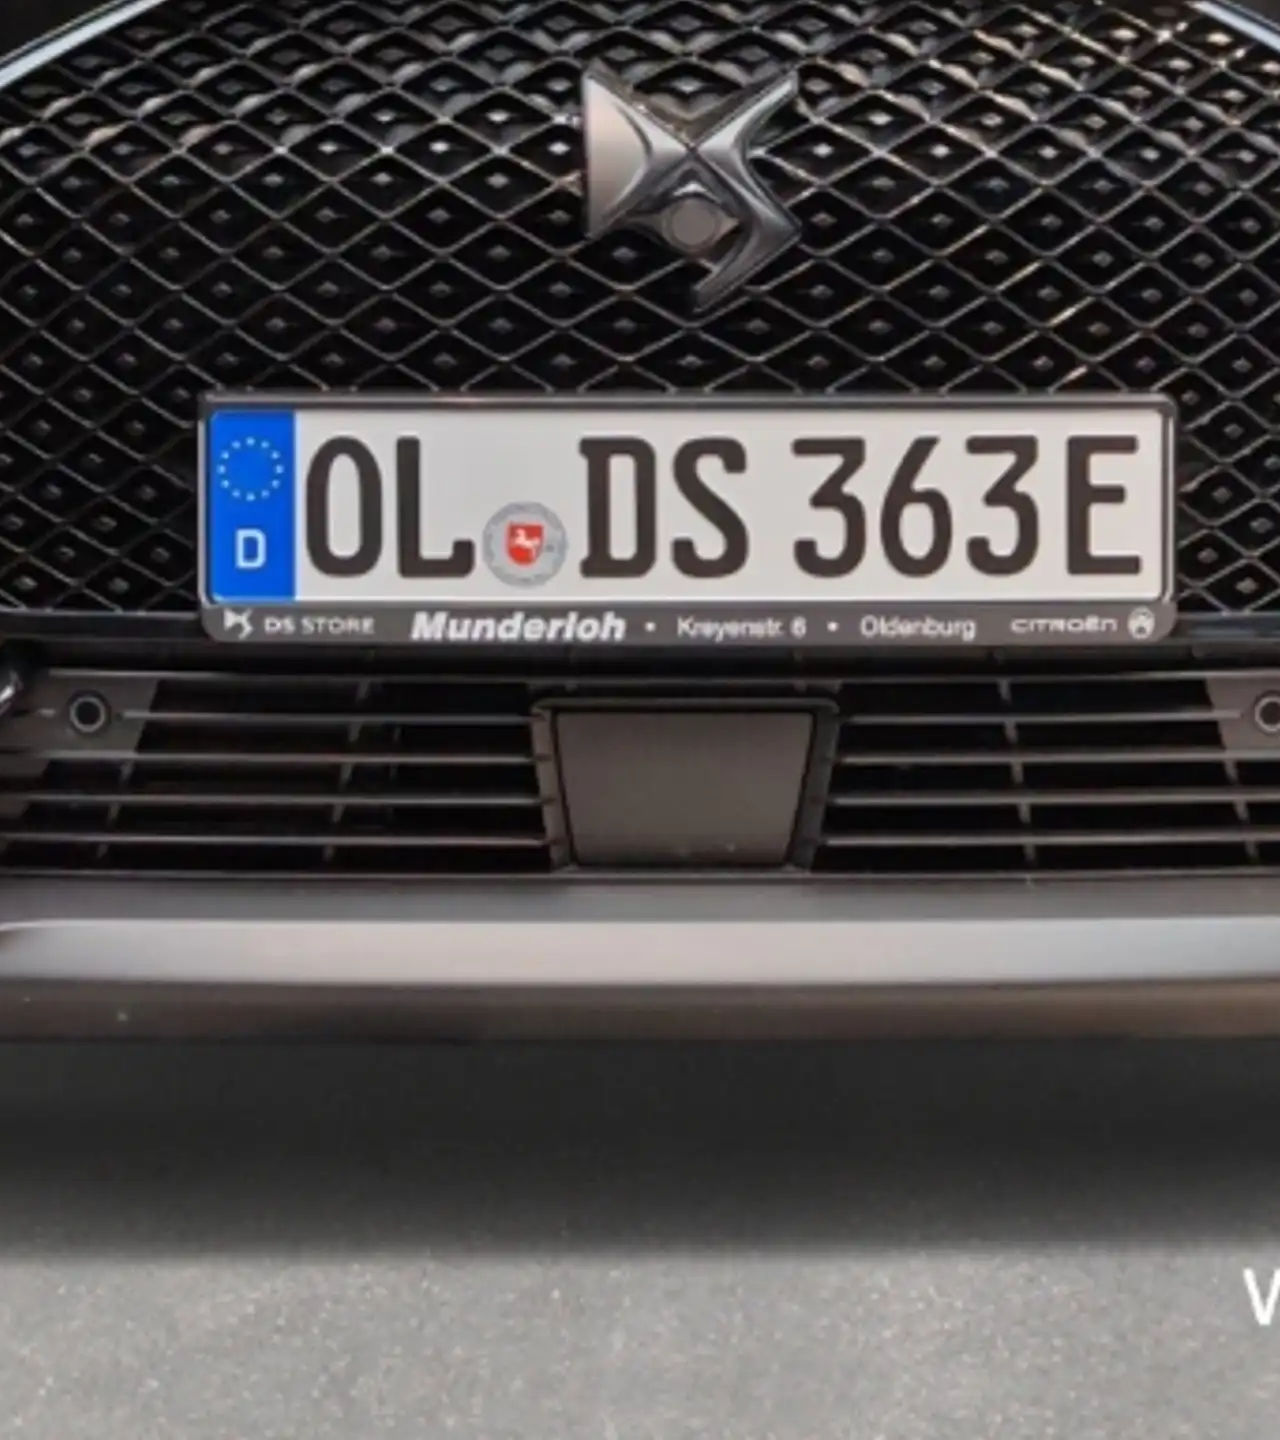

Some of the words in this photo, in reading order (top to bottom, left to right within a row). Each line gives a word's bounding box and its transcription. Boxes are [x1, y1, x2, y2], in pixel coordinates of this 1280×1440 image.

[306, 435, 476, 579] OL
[578, 435, 750, 579] DS
[791, 435, 1142, 579] 363E
[235, 529, 267, 570] D
[263, 616, 297, 635] DS
[301, 616, 376, 635] STORE
[410, 611, 627, 642] Munderloh
[790, 616, 808, 639] 6
[860, 615, 977, 642] Oldenburg
